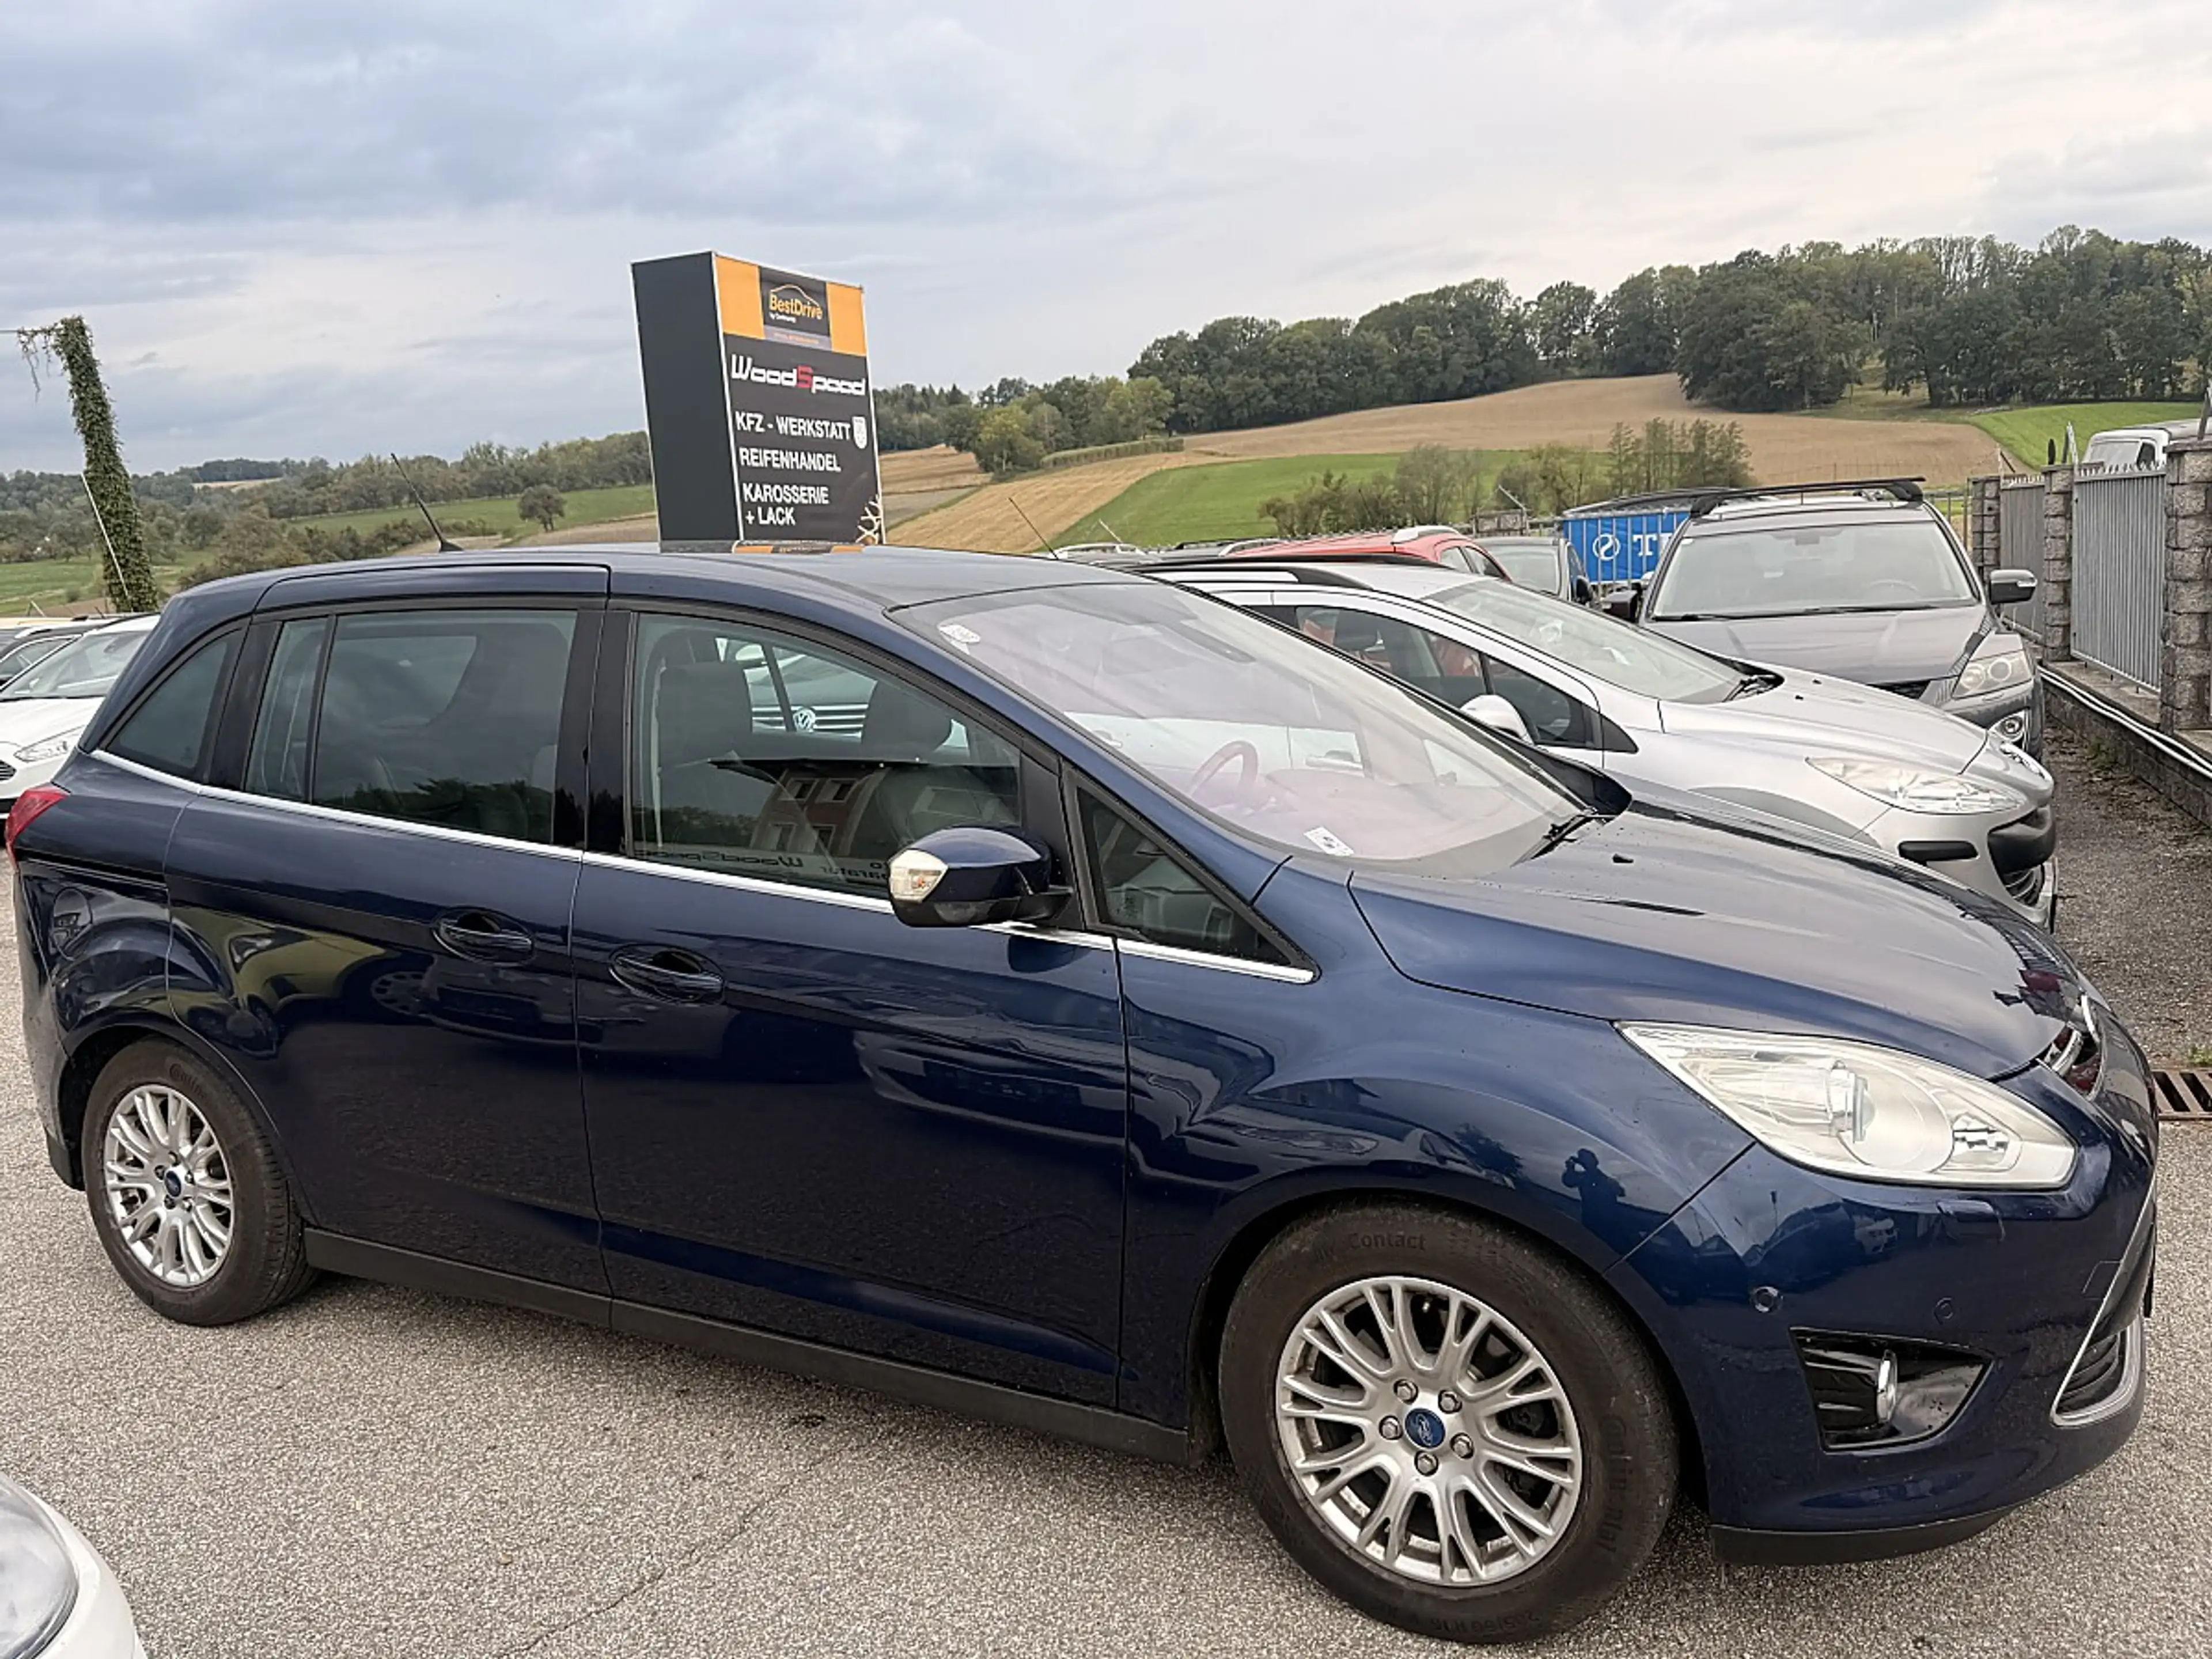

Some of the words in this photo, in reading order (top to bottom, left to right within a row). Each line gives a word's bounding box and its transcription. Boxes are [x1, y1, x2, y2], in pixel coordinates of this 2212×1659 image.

[770, 293, 823, 320] BestDrive
[735, 411, 766, 432] KFZ
[775, 415, 850, 440] WERKSTATT
[739, 446, 842, 472] REIFENHANDEL
[743, 483, 830, 505] KAROSSERIE
[757, 506, 796, 526] LACK
[1348, 1232, 1426, 1251] Contact
